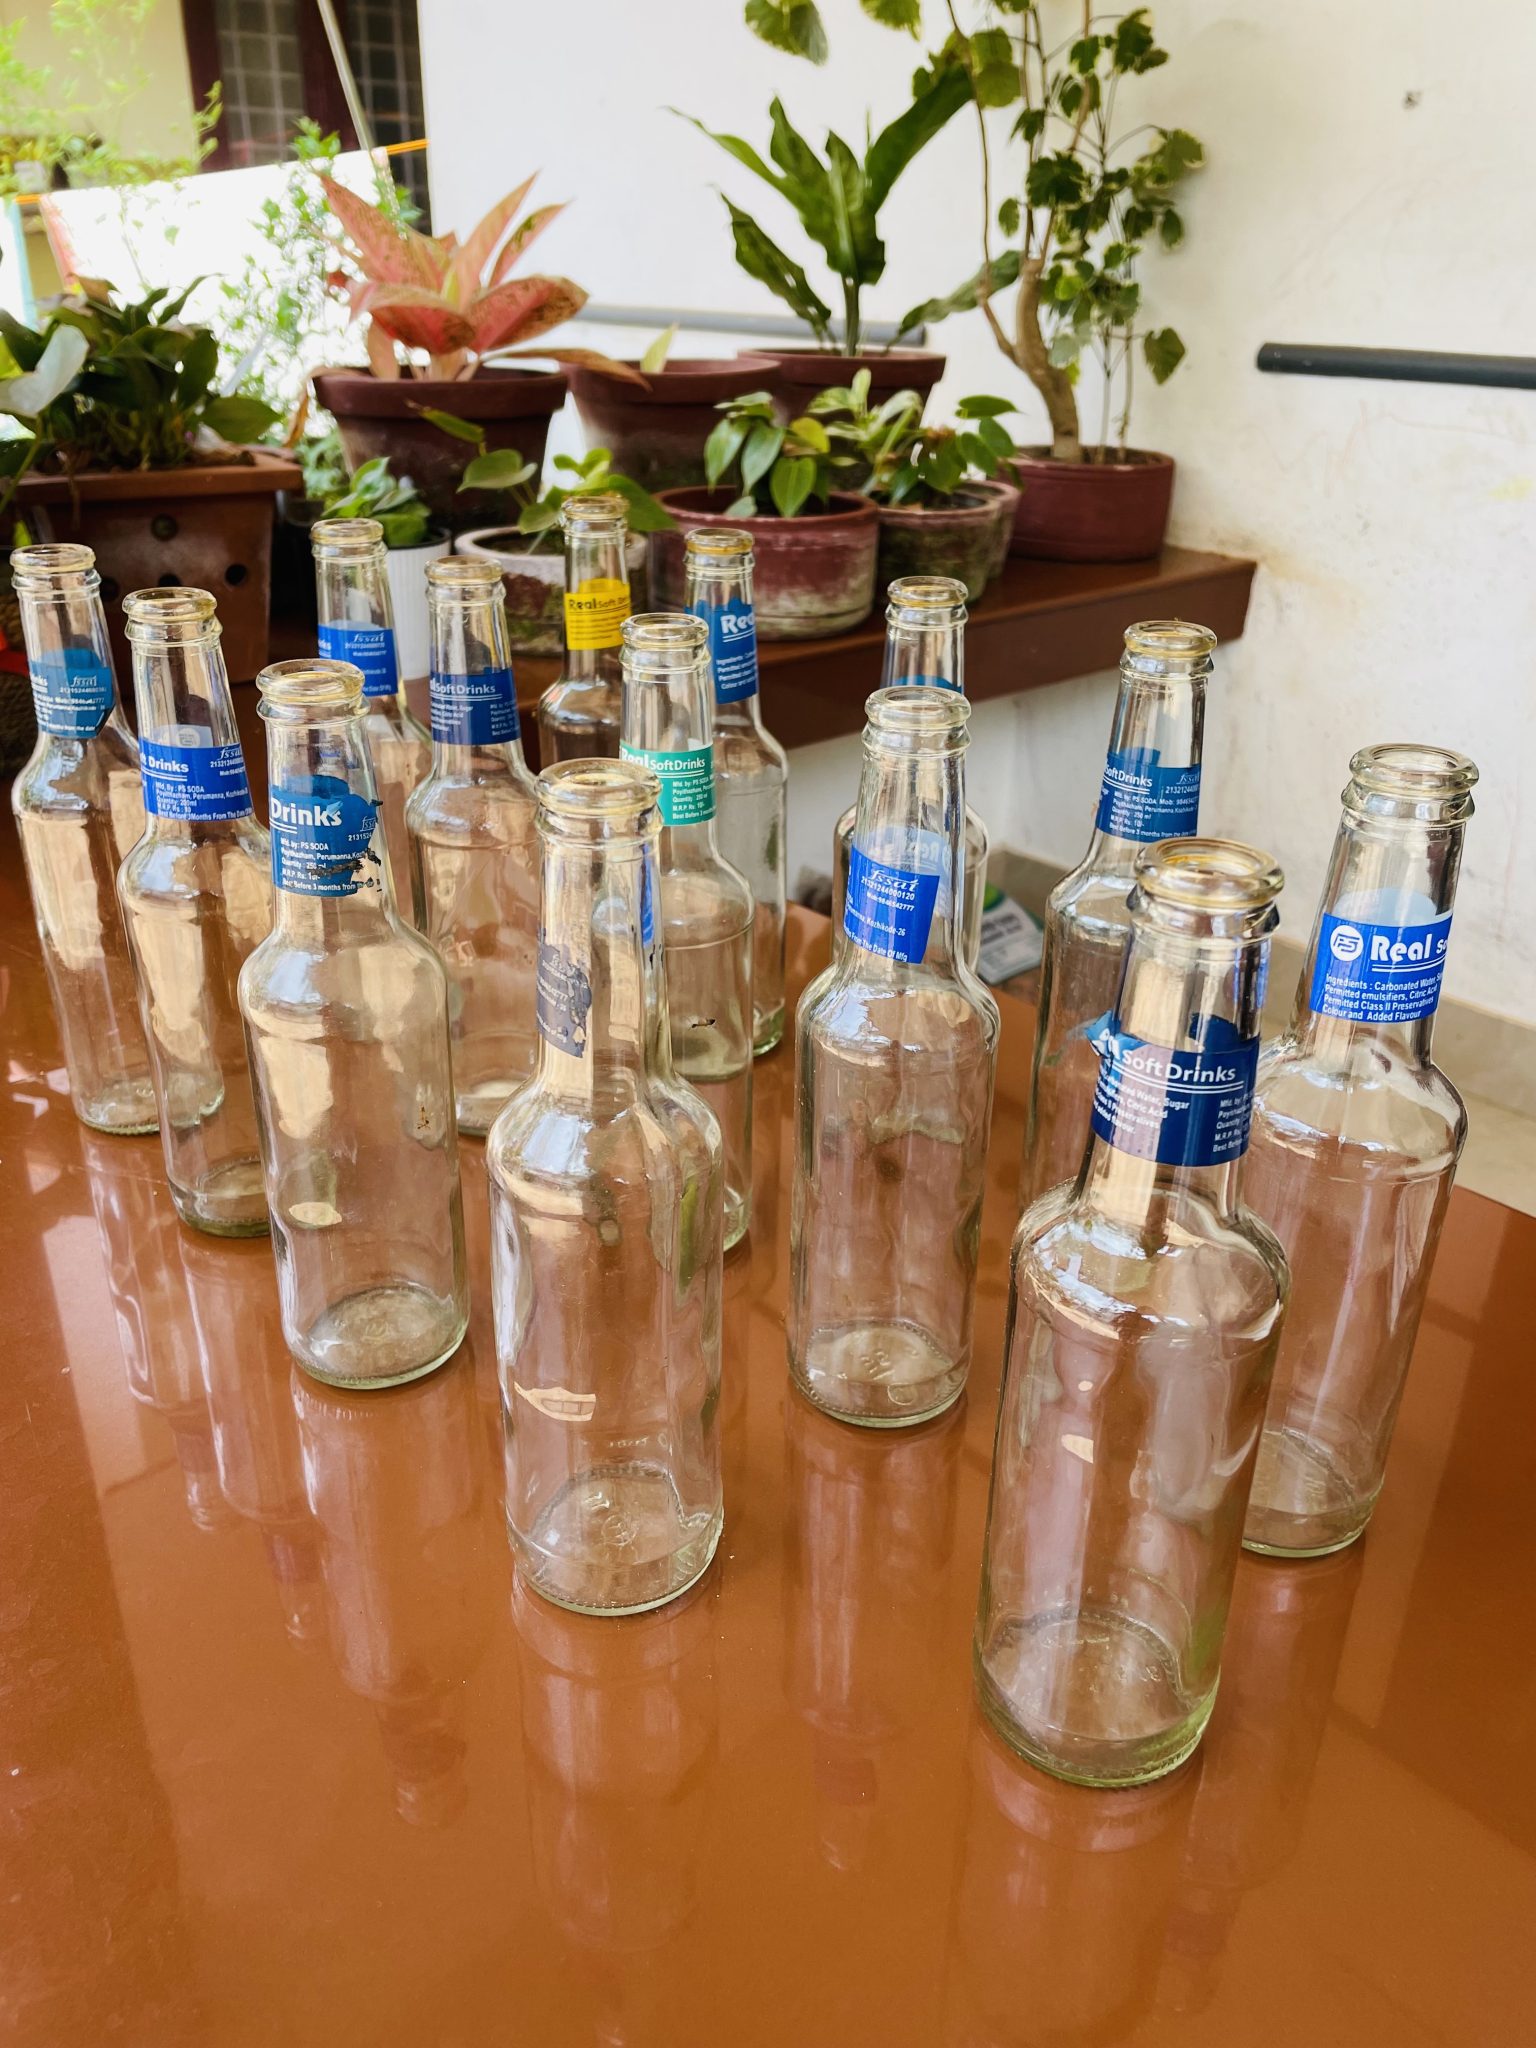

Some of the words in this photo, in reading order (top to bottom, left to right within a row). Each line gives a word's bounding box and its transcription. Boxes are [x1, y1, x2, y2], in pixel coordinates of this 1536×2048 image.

[569, 598, 596, 610] Real
[148, 755, 189, 773] Drinks
[271, 797, 343, 827] Drinks
[300, 841, 309, 849] PS
[310, 842, 329, 851] SODA
[872, 943, 887, 956] Date
[887, 950, 896, 959] Of
[896, 951, 908, 963] Mfg
[1370, 933, 1433, 962] Real
[1325, 983, 1360, 999] Permitted
[1410, 988, 1426, 999] Citric
[1427, 983, 1438, 995] Acid
[1374, 981, 1419, 991] Carbonated
[1324, 993, 1359, 1009] Permitted
[1361, 1000, 1383, 1011] Class
[1392, 996, 1434, 1011] Preservatives
[1322, 1003, 1347, 1018] Colour
[1348, 1010, 1363, 1020] and
[1367, 1011, 1393, 1021] Added
[1395, 1010, 1422, 1020] Flavour
[1127, 1099, 1147, 1114] Citric
[1148, 1106, 1168, 1119] Acid
[1163, 1097, 1190, 1111] Sugar
[1213, 1143, 1227, 1153] Best
